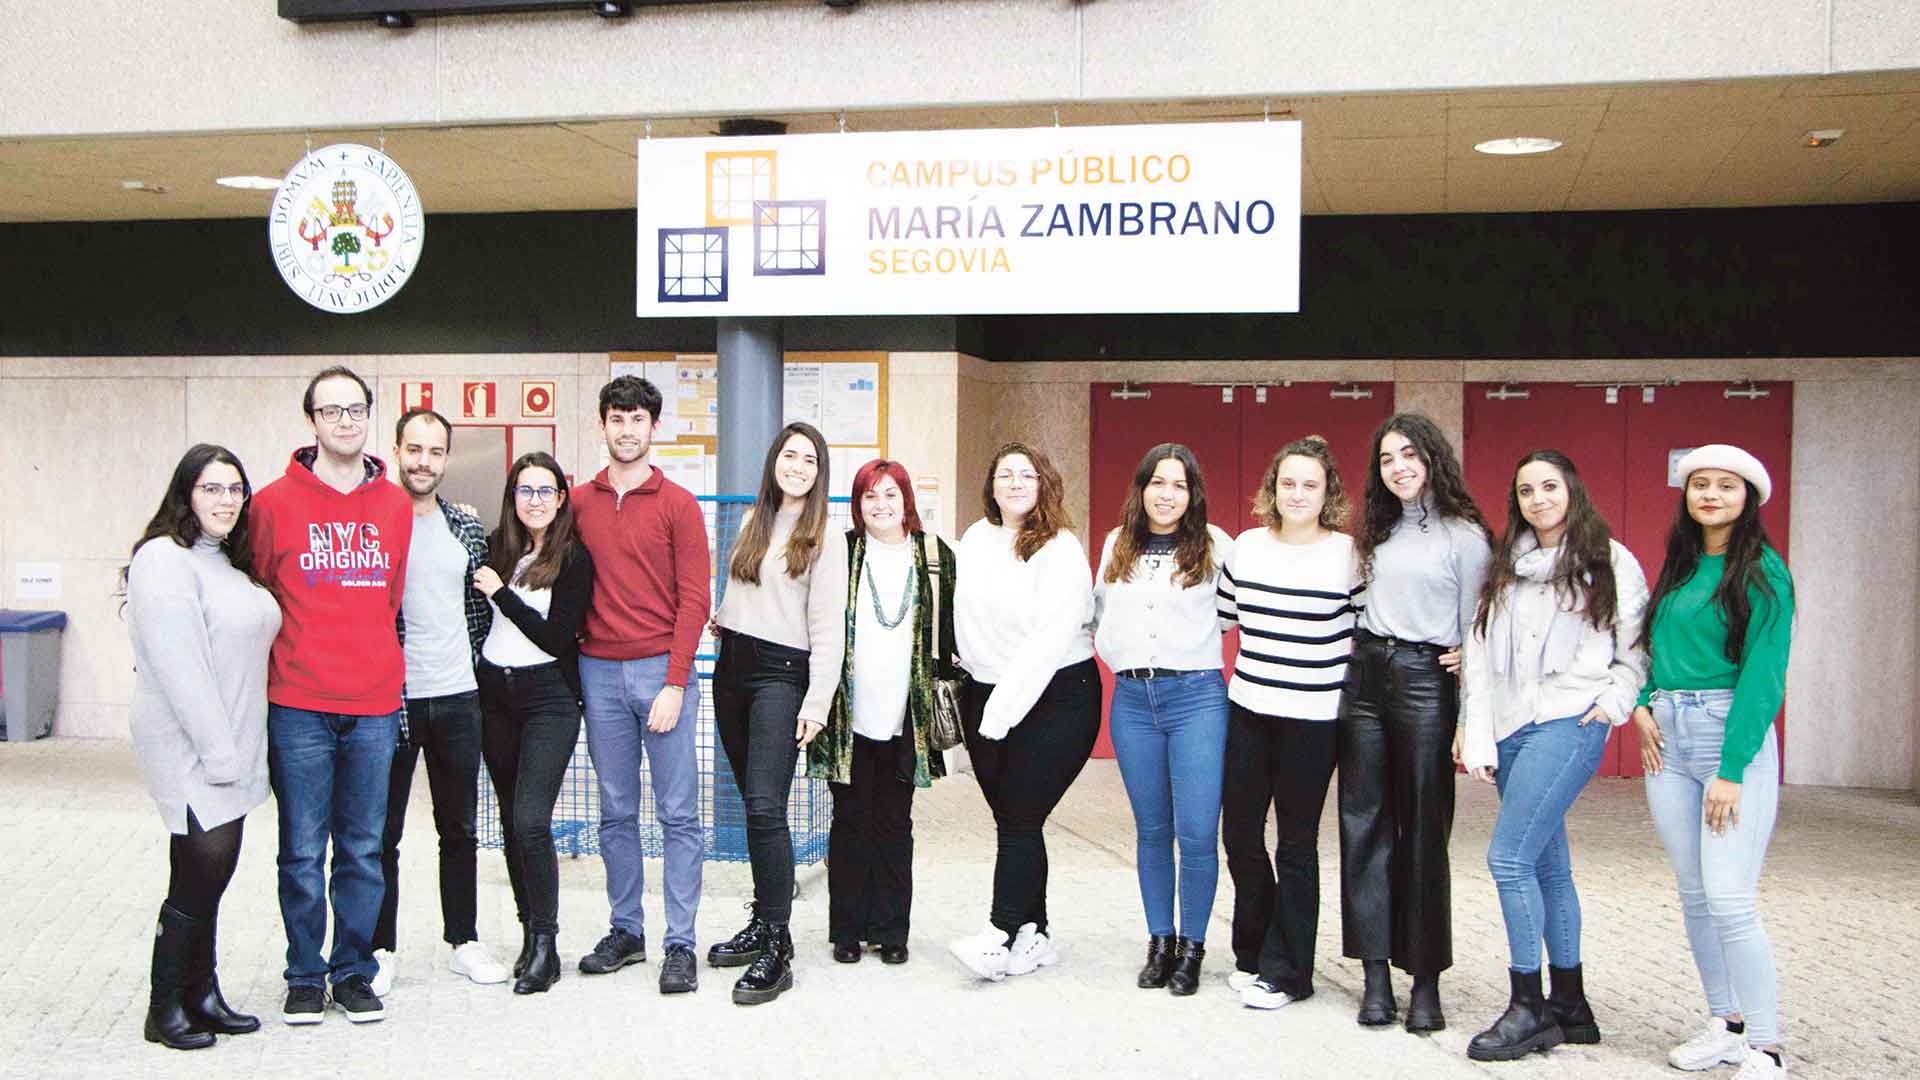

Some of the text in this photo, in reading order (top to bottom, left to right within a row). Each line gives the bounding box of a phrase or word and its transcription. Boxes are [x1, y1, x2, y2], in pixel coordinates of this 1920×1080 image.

[866, 149, 1191, 188] CAMPUS PÚBLICO
[868, 194, 1276, 241] MARÍA ZAMBRANO
[867, 248, 1012, 275] SEGOVIA
[308, 521, 380, 553] NYC
[299, 551, 391, 570] ORIGINAL
